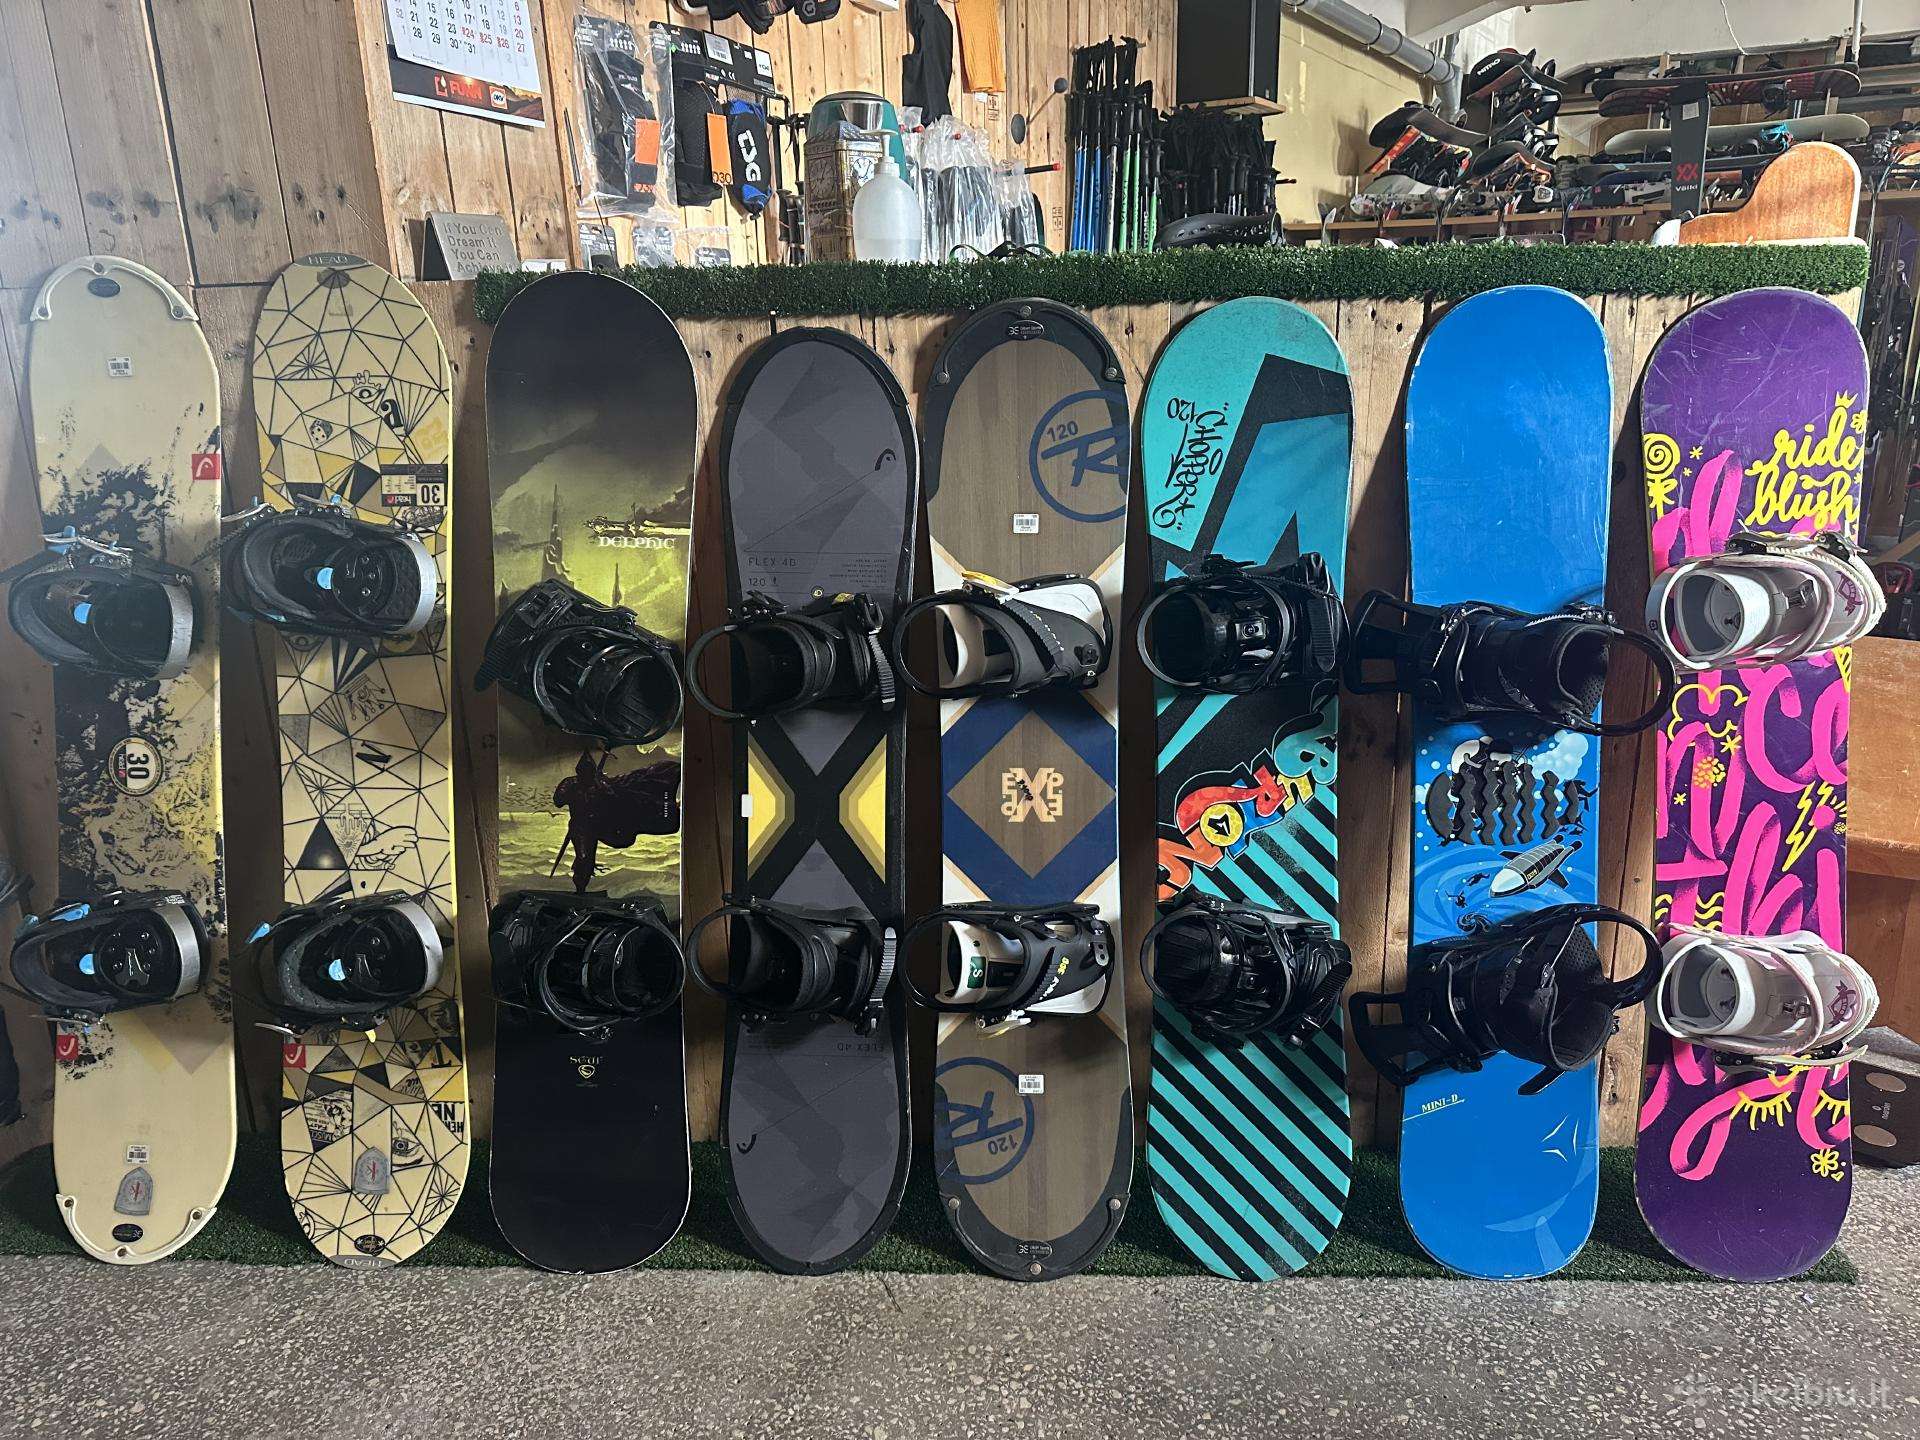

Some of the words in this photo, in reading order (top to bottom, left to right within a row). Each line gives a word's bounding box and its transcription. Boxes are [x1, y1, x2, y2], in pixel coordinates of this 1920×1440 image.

[427, 1, 436, 13] 15
[446, 7, 455, 19] 16
[482, 19, 491, 30] 18
[498, 24, 507, 35] 19
[514, 28, 524, 39] 20
[479, 4, 487, 15] 11
[497, 10, 505, 20] 12
[514, 15, 522, 26] 13
[410, 11, 419, 23] 21
[429, 17, 438, 29] 22
[447, 22, 457, 34] 23
[465, 28, 475, 39] 24
[483, 34, 493, 45] 25
[500, 38, 510, 49] 26
[517, 43, 525, 53] 27
[412, 26, 423, 39] 28
[431, 32, 441, 45] 29
[449, 38, 459, 49] 30
[468, 43, 476, 54] 31
[1477, 58, 1500, 76] NITRO
[453, 223, 477, 235] You
[480, 223, 502, 236] Can
[447, 235, 485, 248] Dream
[451, 248, 474, 260] You
[477, 249, 500, 261] Can
[1046, 420, 1079, 442] 120
[1766, 406, 1866, 471] ride
[421, 484, 441, 505] 30
[1745, 461, 1859, 529] blush
[748, 557, 776, 567] FLEX
[749, 577, 766, 587] 120
[128, 753, 150, 779] 30
[1421, 1093, 1458, 1113] MINI-D
[987, 1134, 1018, 1155] 120
[344, 1258, 383, 1267] HEAD
